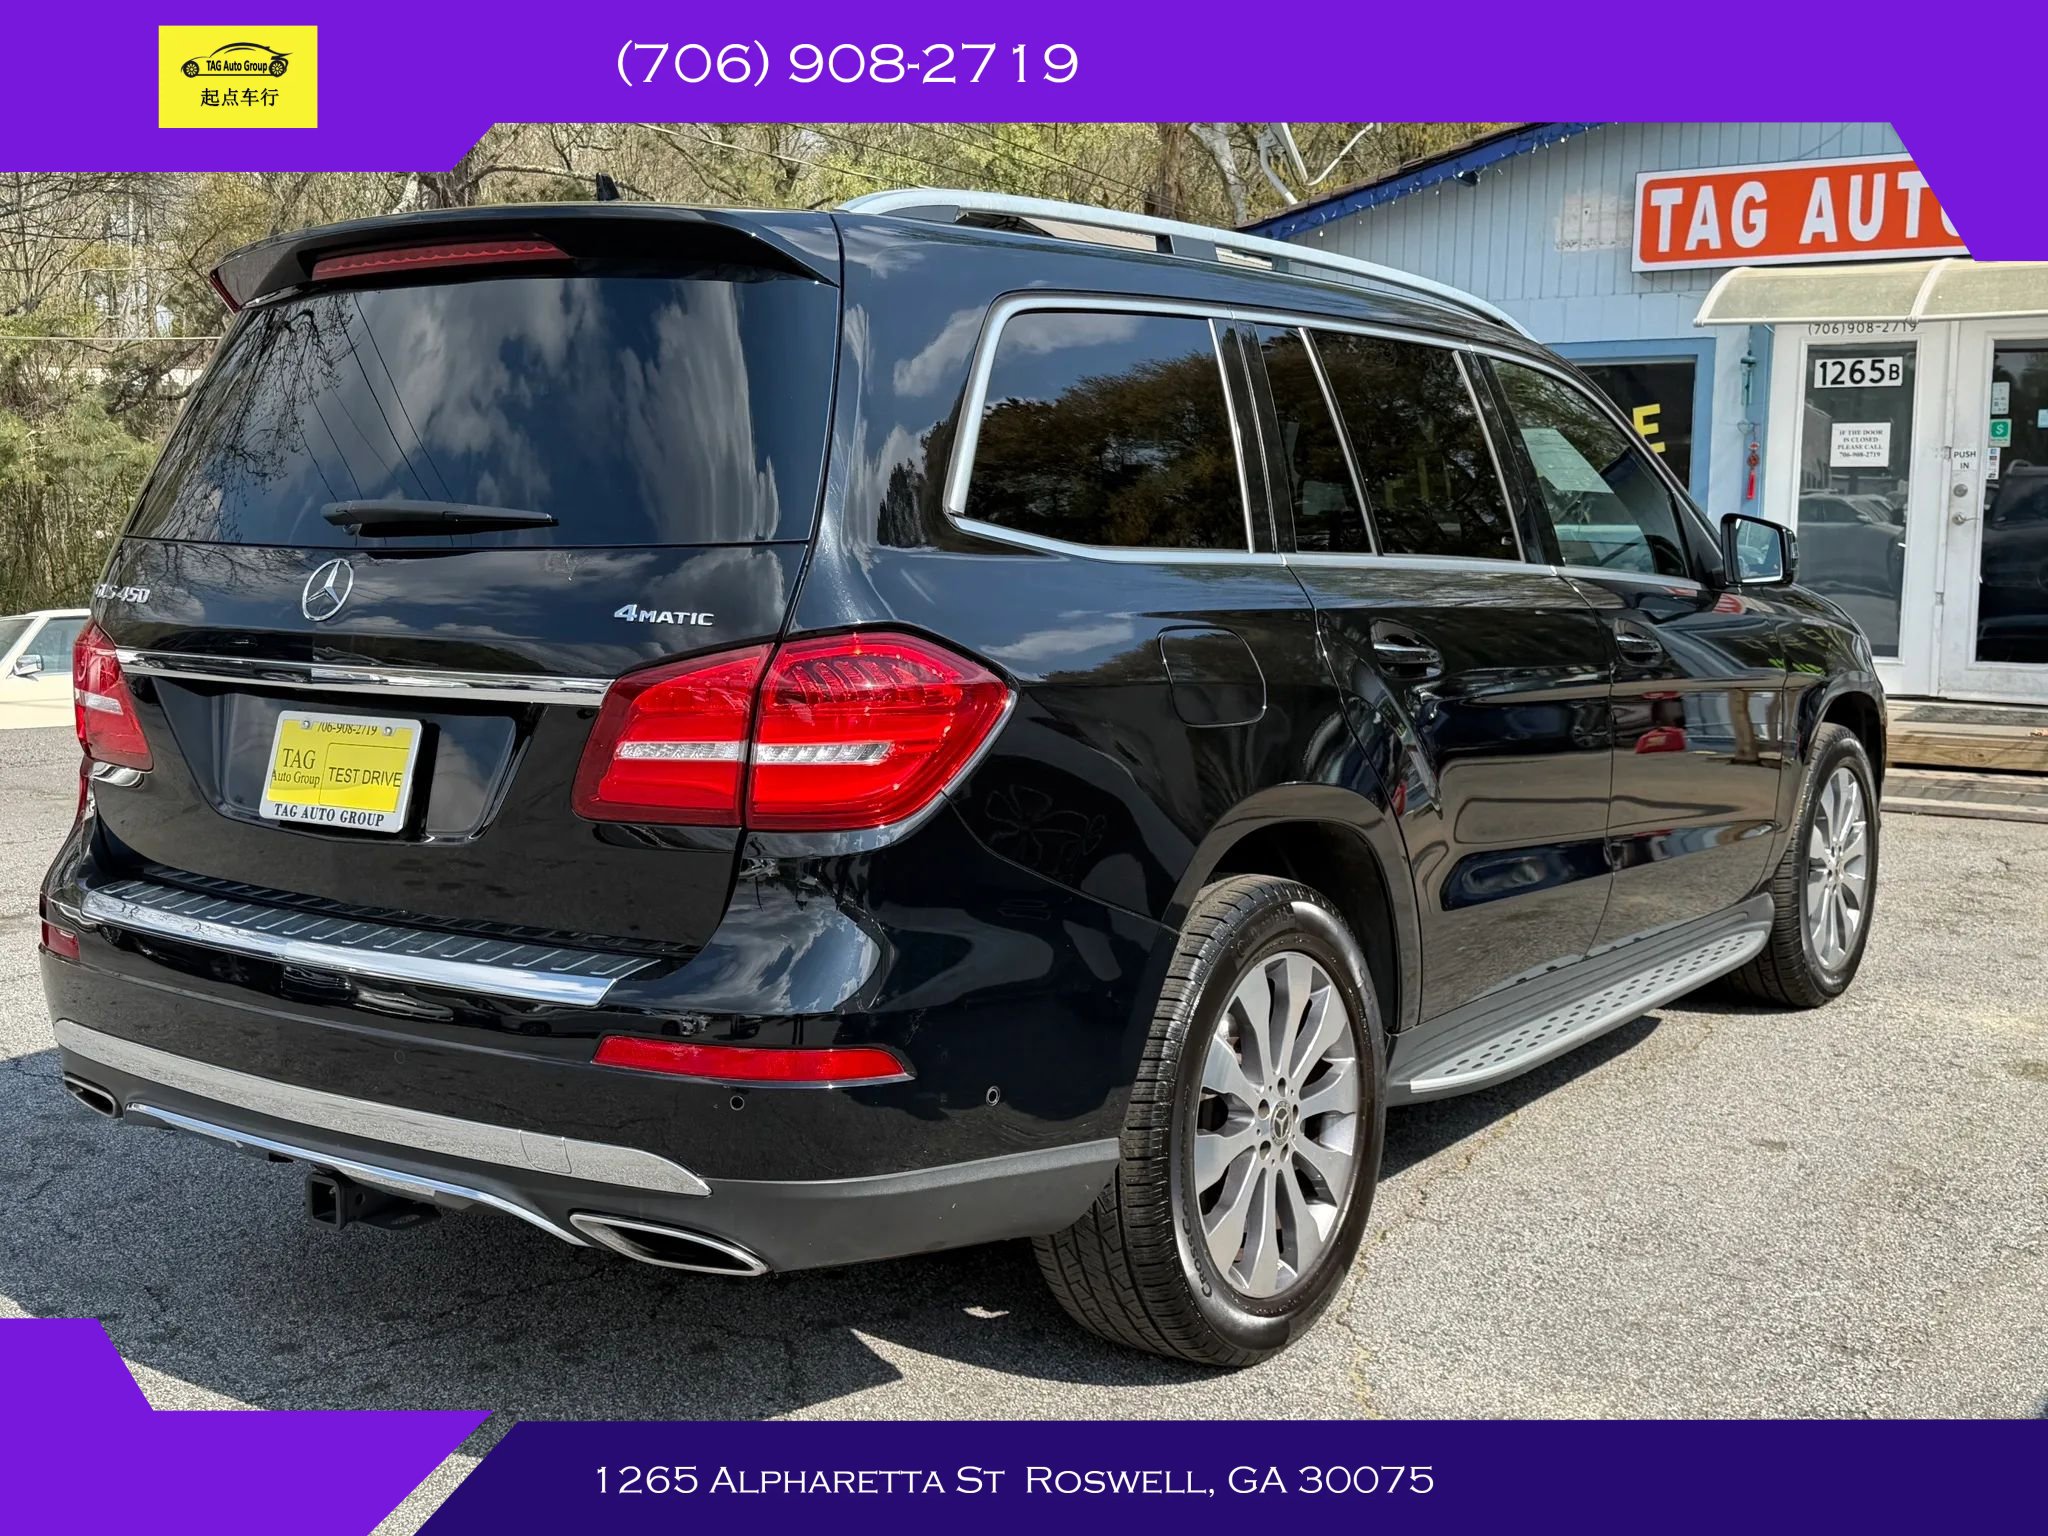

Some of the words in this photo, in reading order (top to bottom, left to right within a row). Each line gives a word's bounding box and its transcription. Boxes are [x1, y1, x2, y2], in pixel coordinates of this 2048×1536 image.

[1650, 180, 1768, 253] TAG
[1953, 450, 1977, 459] PUSH
[116, 586, 151, 604] 450
[613, 604, 715, 626] 4MATIC
[283, 748, 316, 770] TAG
[271, 769, 292, 783] Auto
[293, 771, 321, 789] Group
[328, 766, 361, 784] TEST
[361, 770, 402, 788] DRIVE
[274, 803, 298, 818] TAG
[300, 807, 336, 822] AUTO
[340, 811, 385, 827] GROUP
